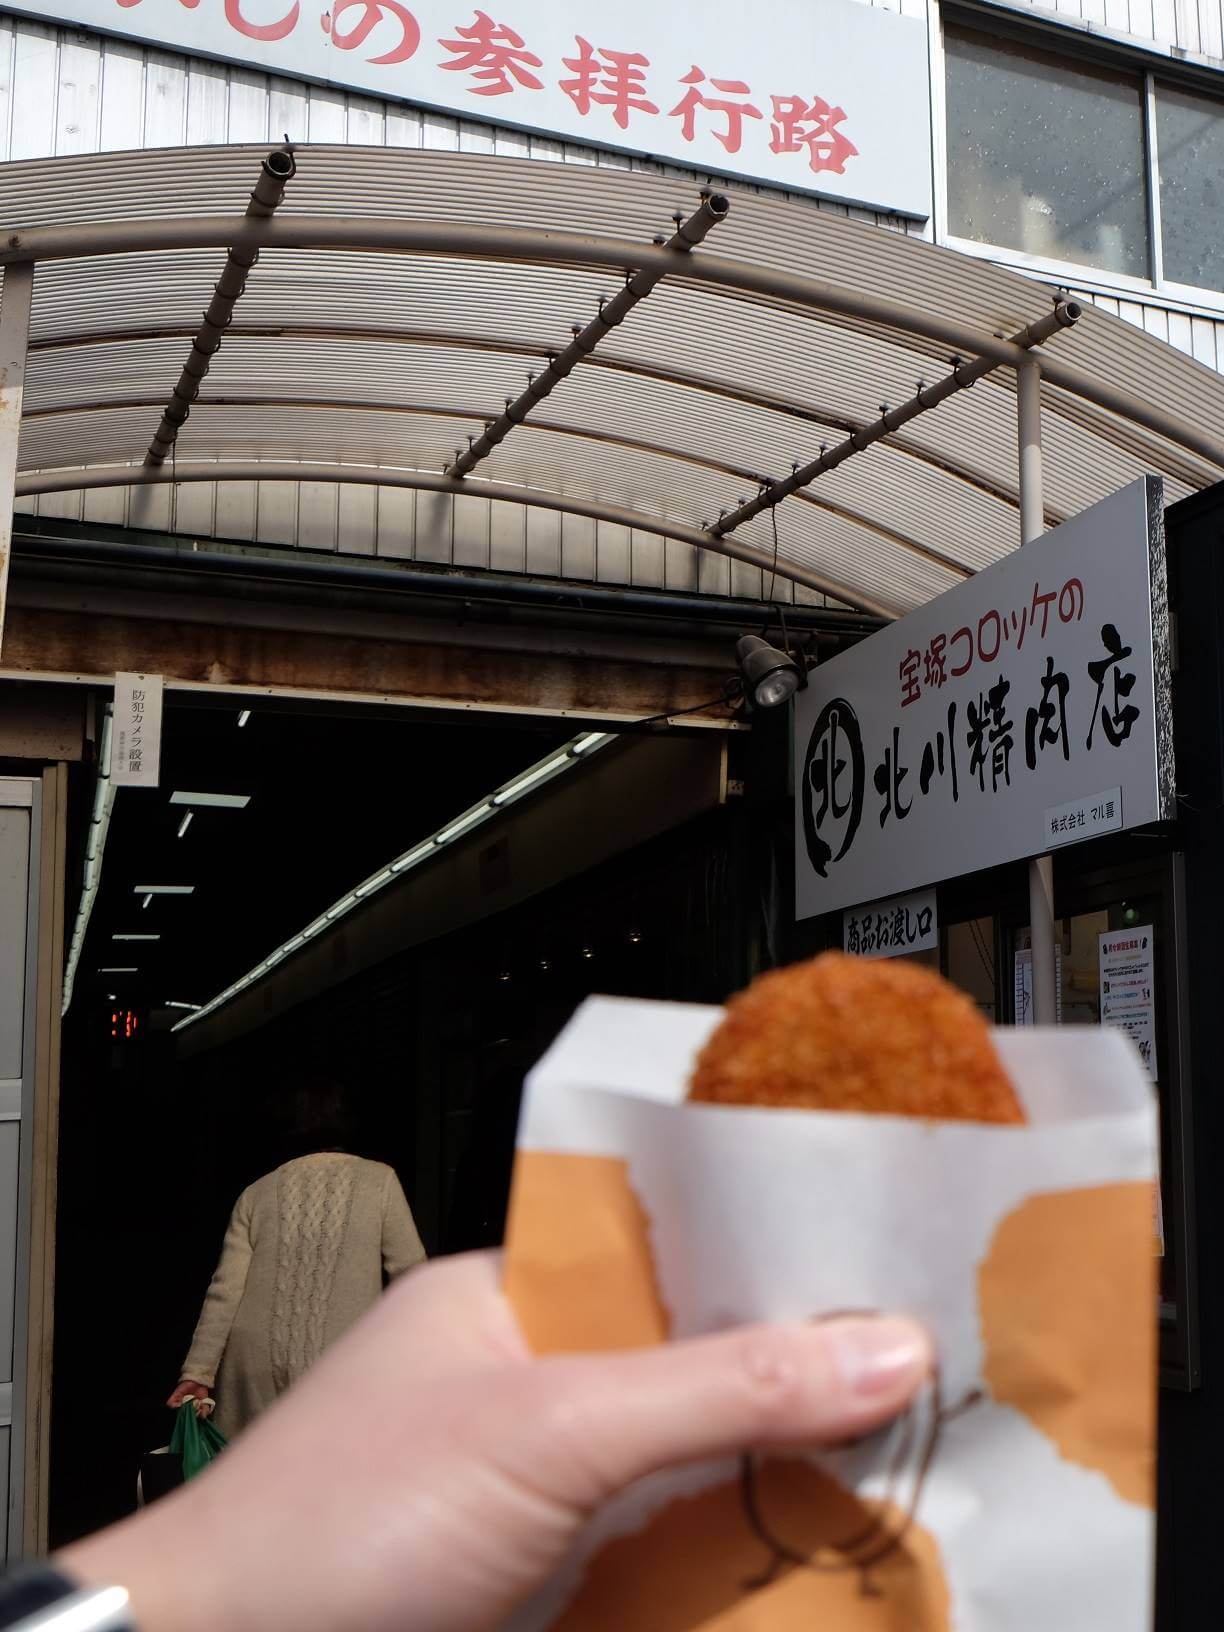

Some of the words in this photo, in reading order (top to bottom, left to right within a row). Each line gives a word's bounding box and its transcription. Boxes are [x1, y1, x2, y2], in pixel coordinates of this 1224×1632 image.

[116, 0, 860, 175] しの参拝行路
[900, 577, 1084, 708] 宝塚コロッケの
[129, 689, 145, 772] 防犯カメラ設置
[873, 623, 1141, 829] 北川精肉店
[1050, 810, 1086, 836] 株式会社
[847, 906, 933, 957] 商品お渡し口
